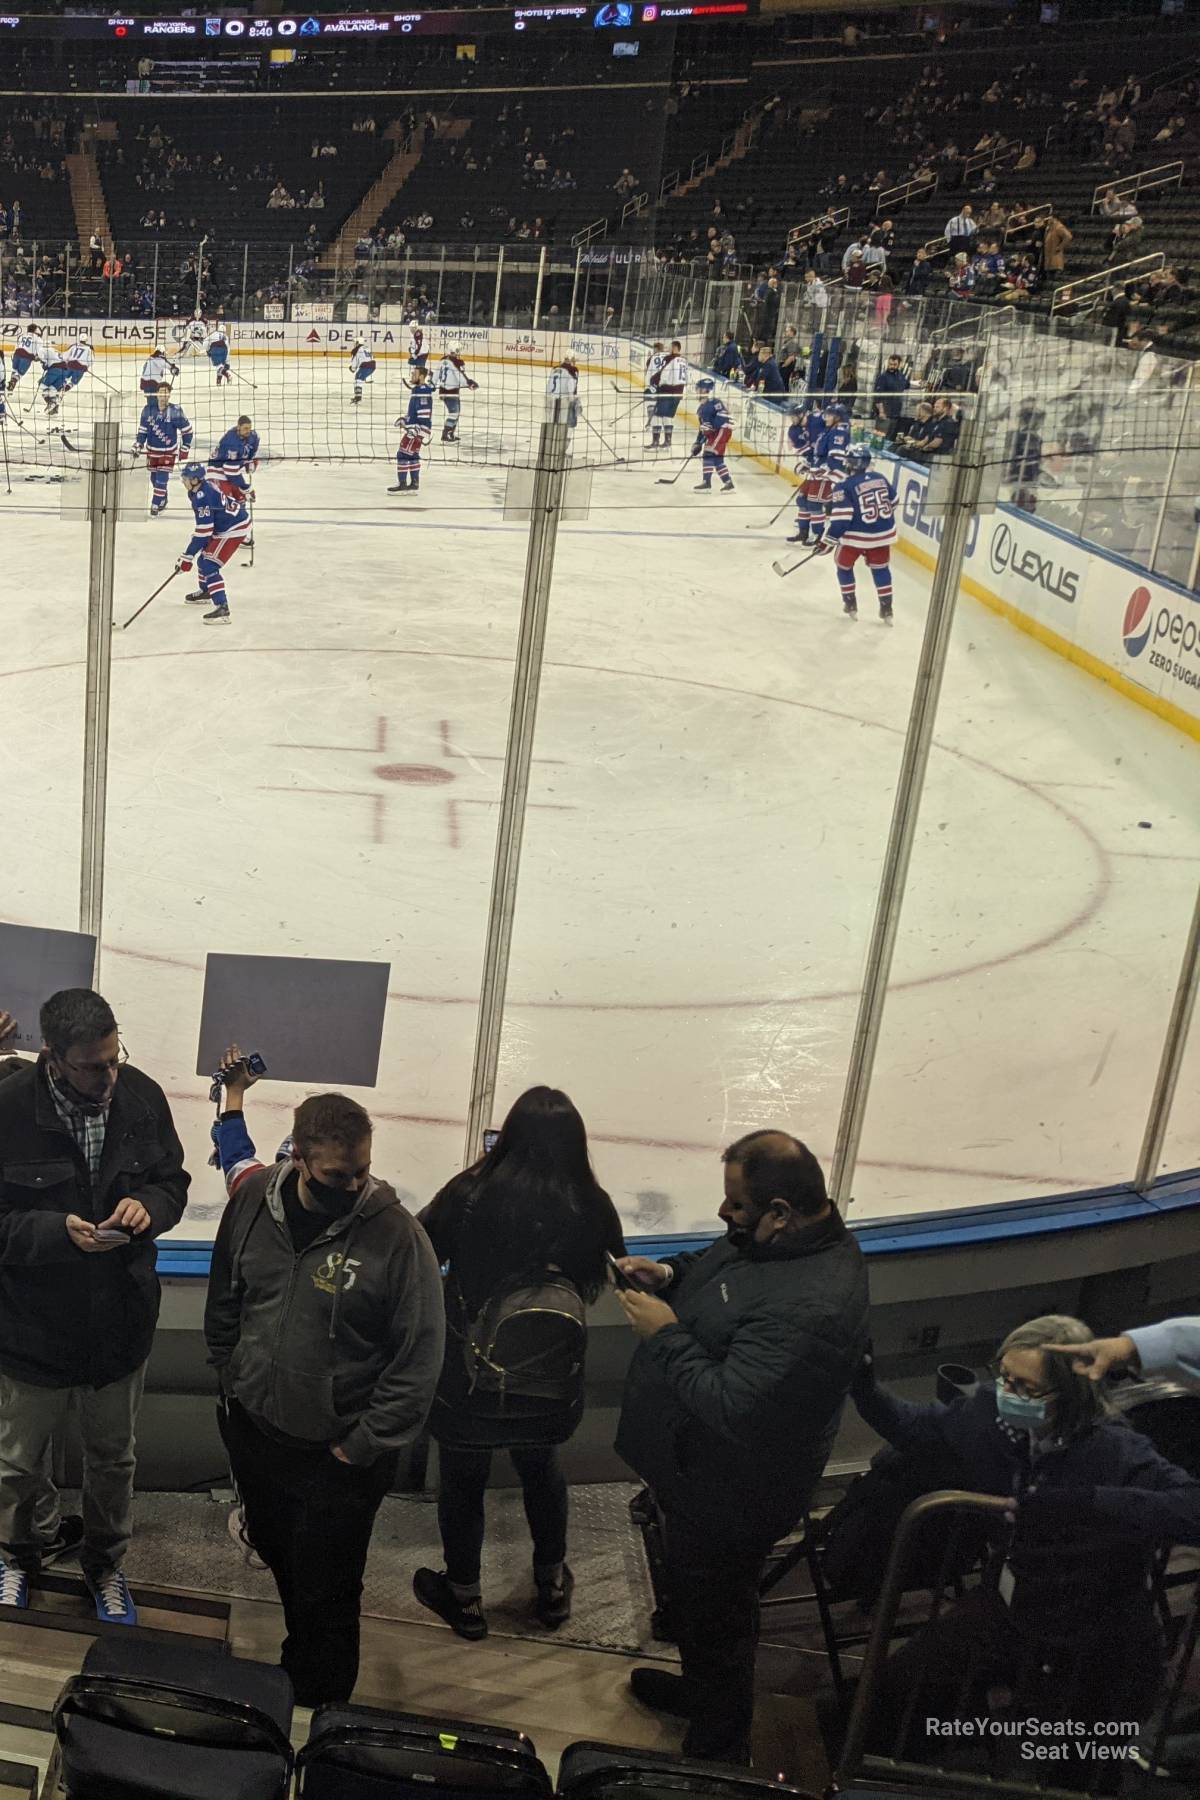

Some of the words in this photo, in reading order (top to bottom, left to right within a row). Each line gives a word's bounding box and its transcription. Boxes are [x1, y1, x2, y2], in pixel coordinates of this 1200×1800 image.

[660, 8, 693, 16] FOLLOW
[143, 26, 196, 34] RANGERS
[225, 20, 244, 36] 0
[249, 27, 273, 37] 8:40
[278, 20, 297, 35] 0
[324, 23, 389, 32] AVALANCHE
[102, 325, 166, 340] CHASE
[328, 329, 394, 343] DELTA
[440, 328, 489, 340] Northwell
[859, 489, 894, 525] 55
[1010, 543, 1080, 604] LEXUS
[1149, 650, 1172, 673] ZERO
